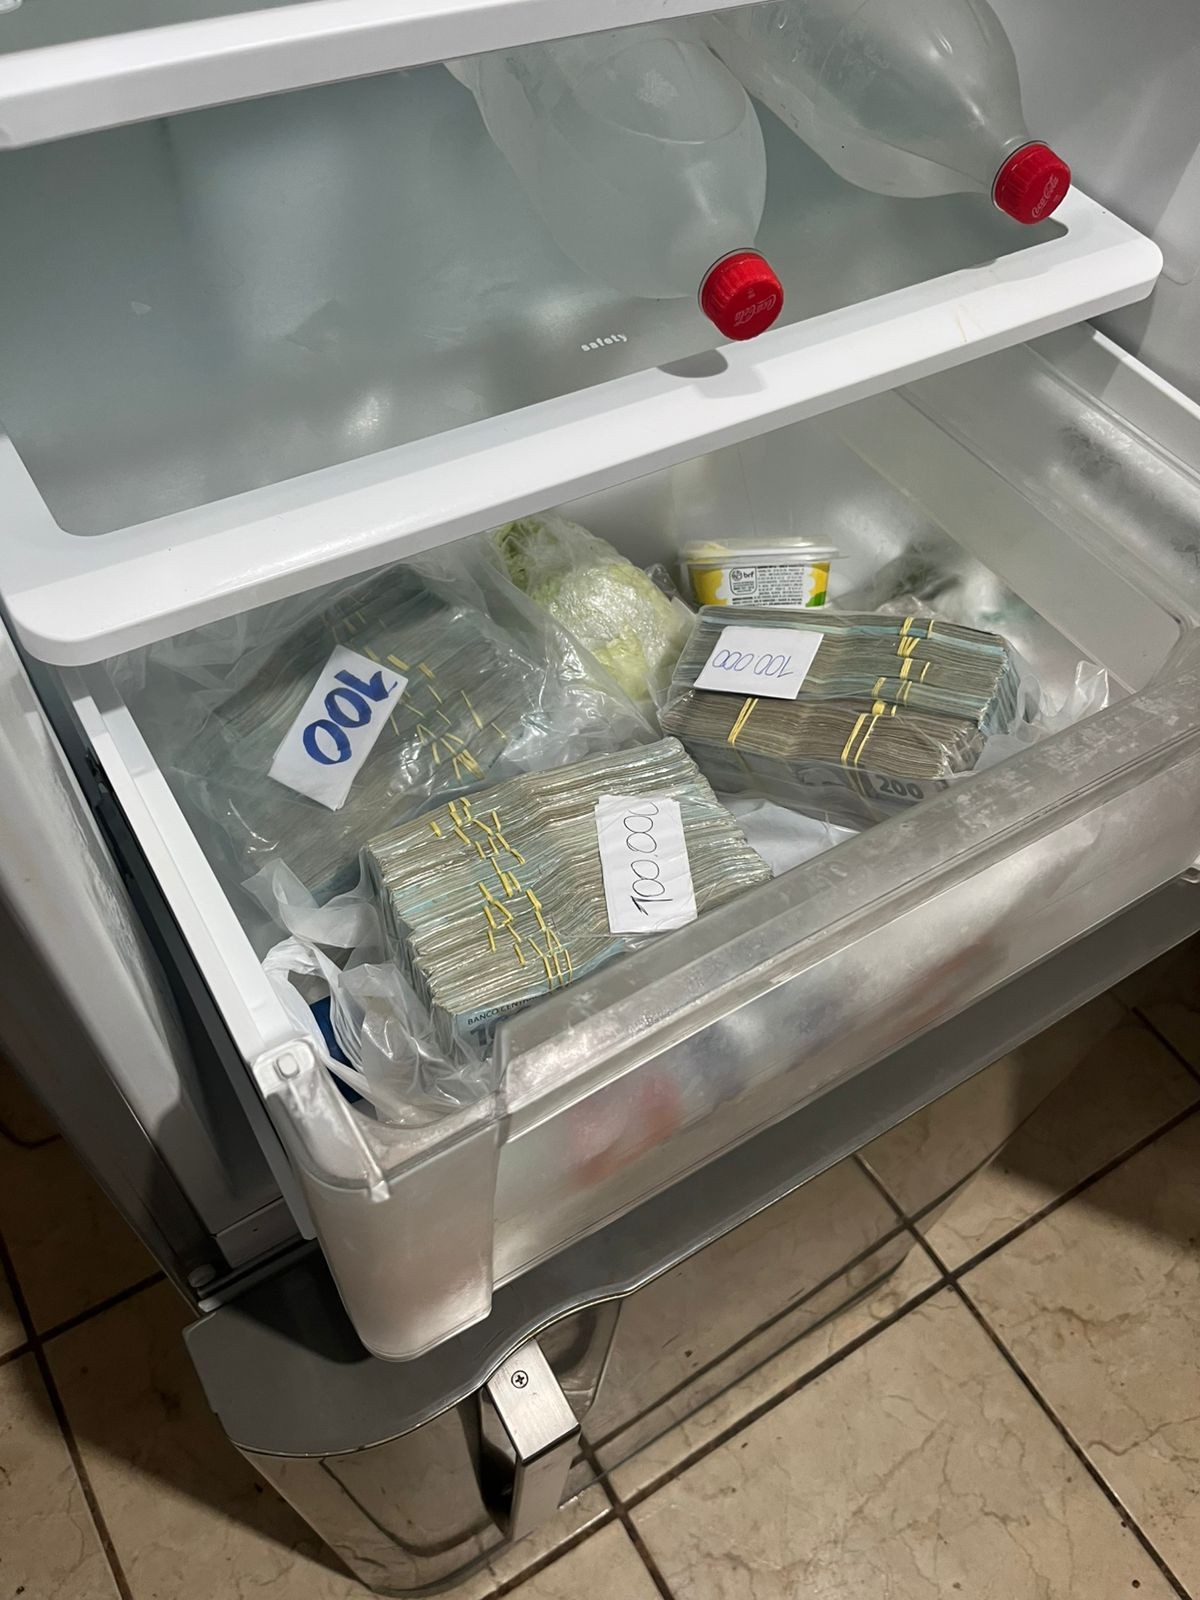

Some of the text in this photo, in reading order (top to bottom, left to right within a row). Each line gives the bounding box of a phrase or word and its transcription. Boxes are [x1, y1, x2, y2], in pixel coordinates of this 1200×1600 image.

[581, 334, 628, 351] safety
[302, 669, 398, 765] 100
[875, 774, 924, 799] 200
[467, 1008, 499, 1025] BANCO
